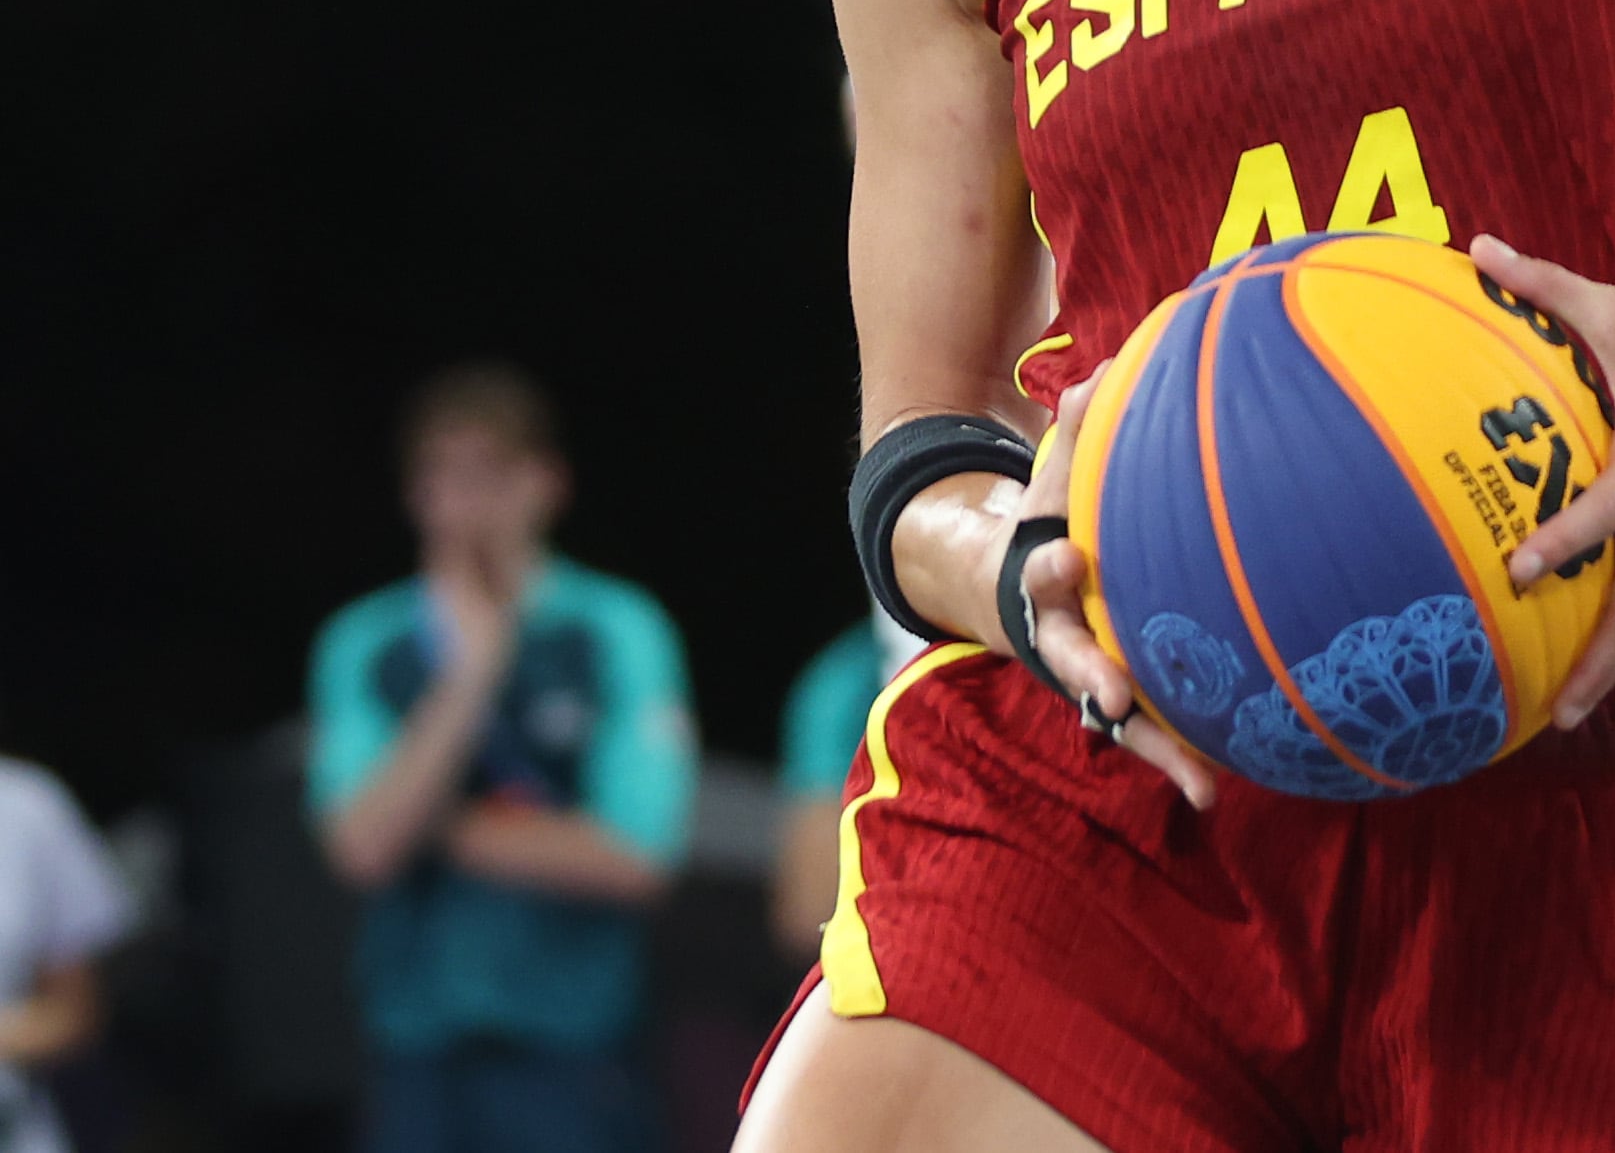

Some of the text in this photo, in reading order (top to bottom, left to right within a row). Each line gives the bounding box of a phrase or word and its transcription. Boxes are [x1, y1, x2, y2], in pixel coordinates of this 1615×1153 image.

[1208, 106, 1451, 270] 44
[1443, 450, 1508, 548] OFFICIAL
[1478, 463, 1518, 517] FIBA
